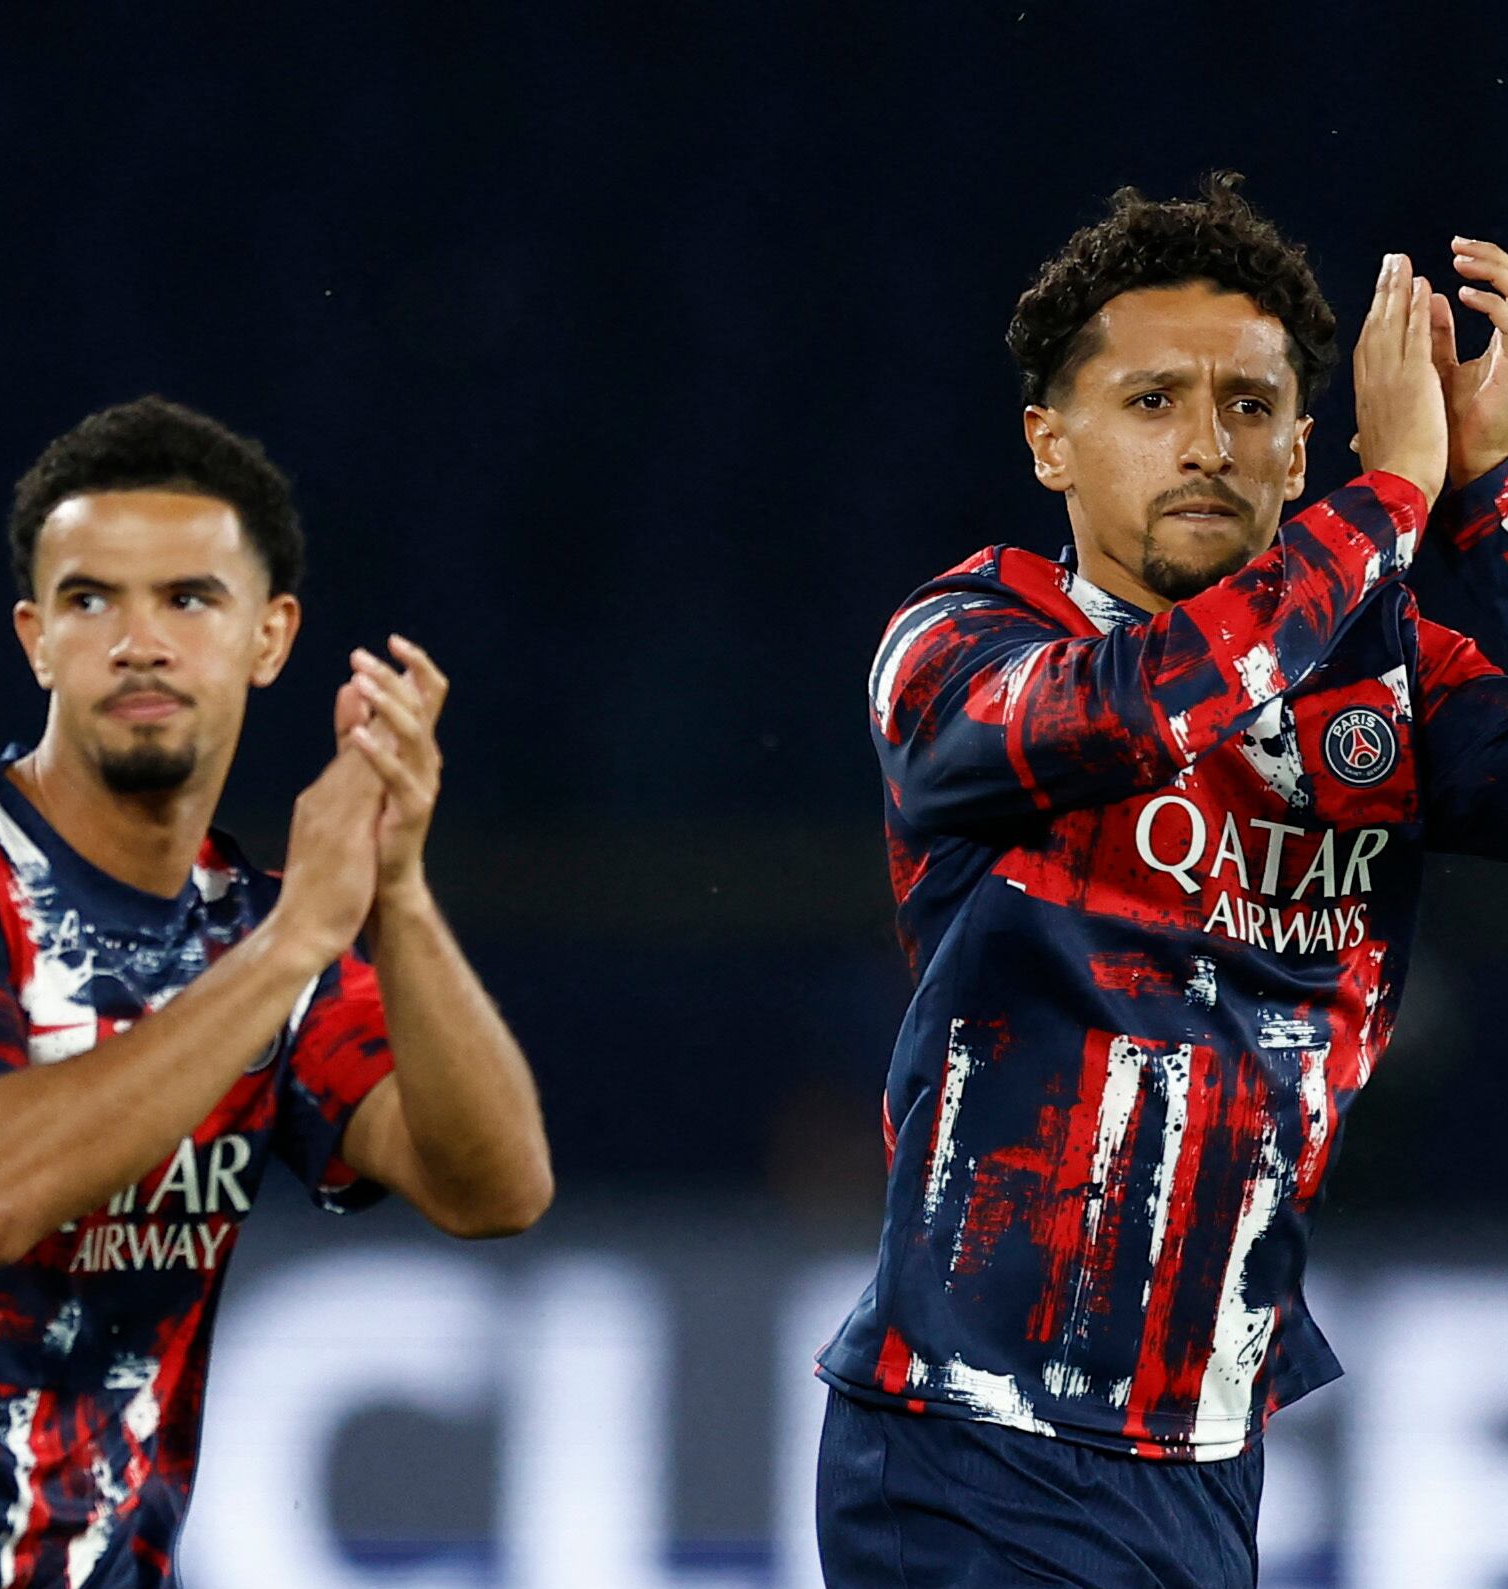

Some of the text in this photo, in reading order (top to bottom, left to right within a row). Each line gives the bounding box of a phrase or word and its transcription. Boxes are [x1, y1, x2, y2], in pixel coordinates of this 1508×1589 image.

[1333, 714, 1376, 737] PARIS
[1135, 795, 1389, 900] QATAR
[1203, 890, 1367, 954] AIRWAYS
